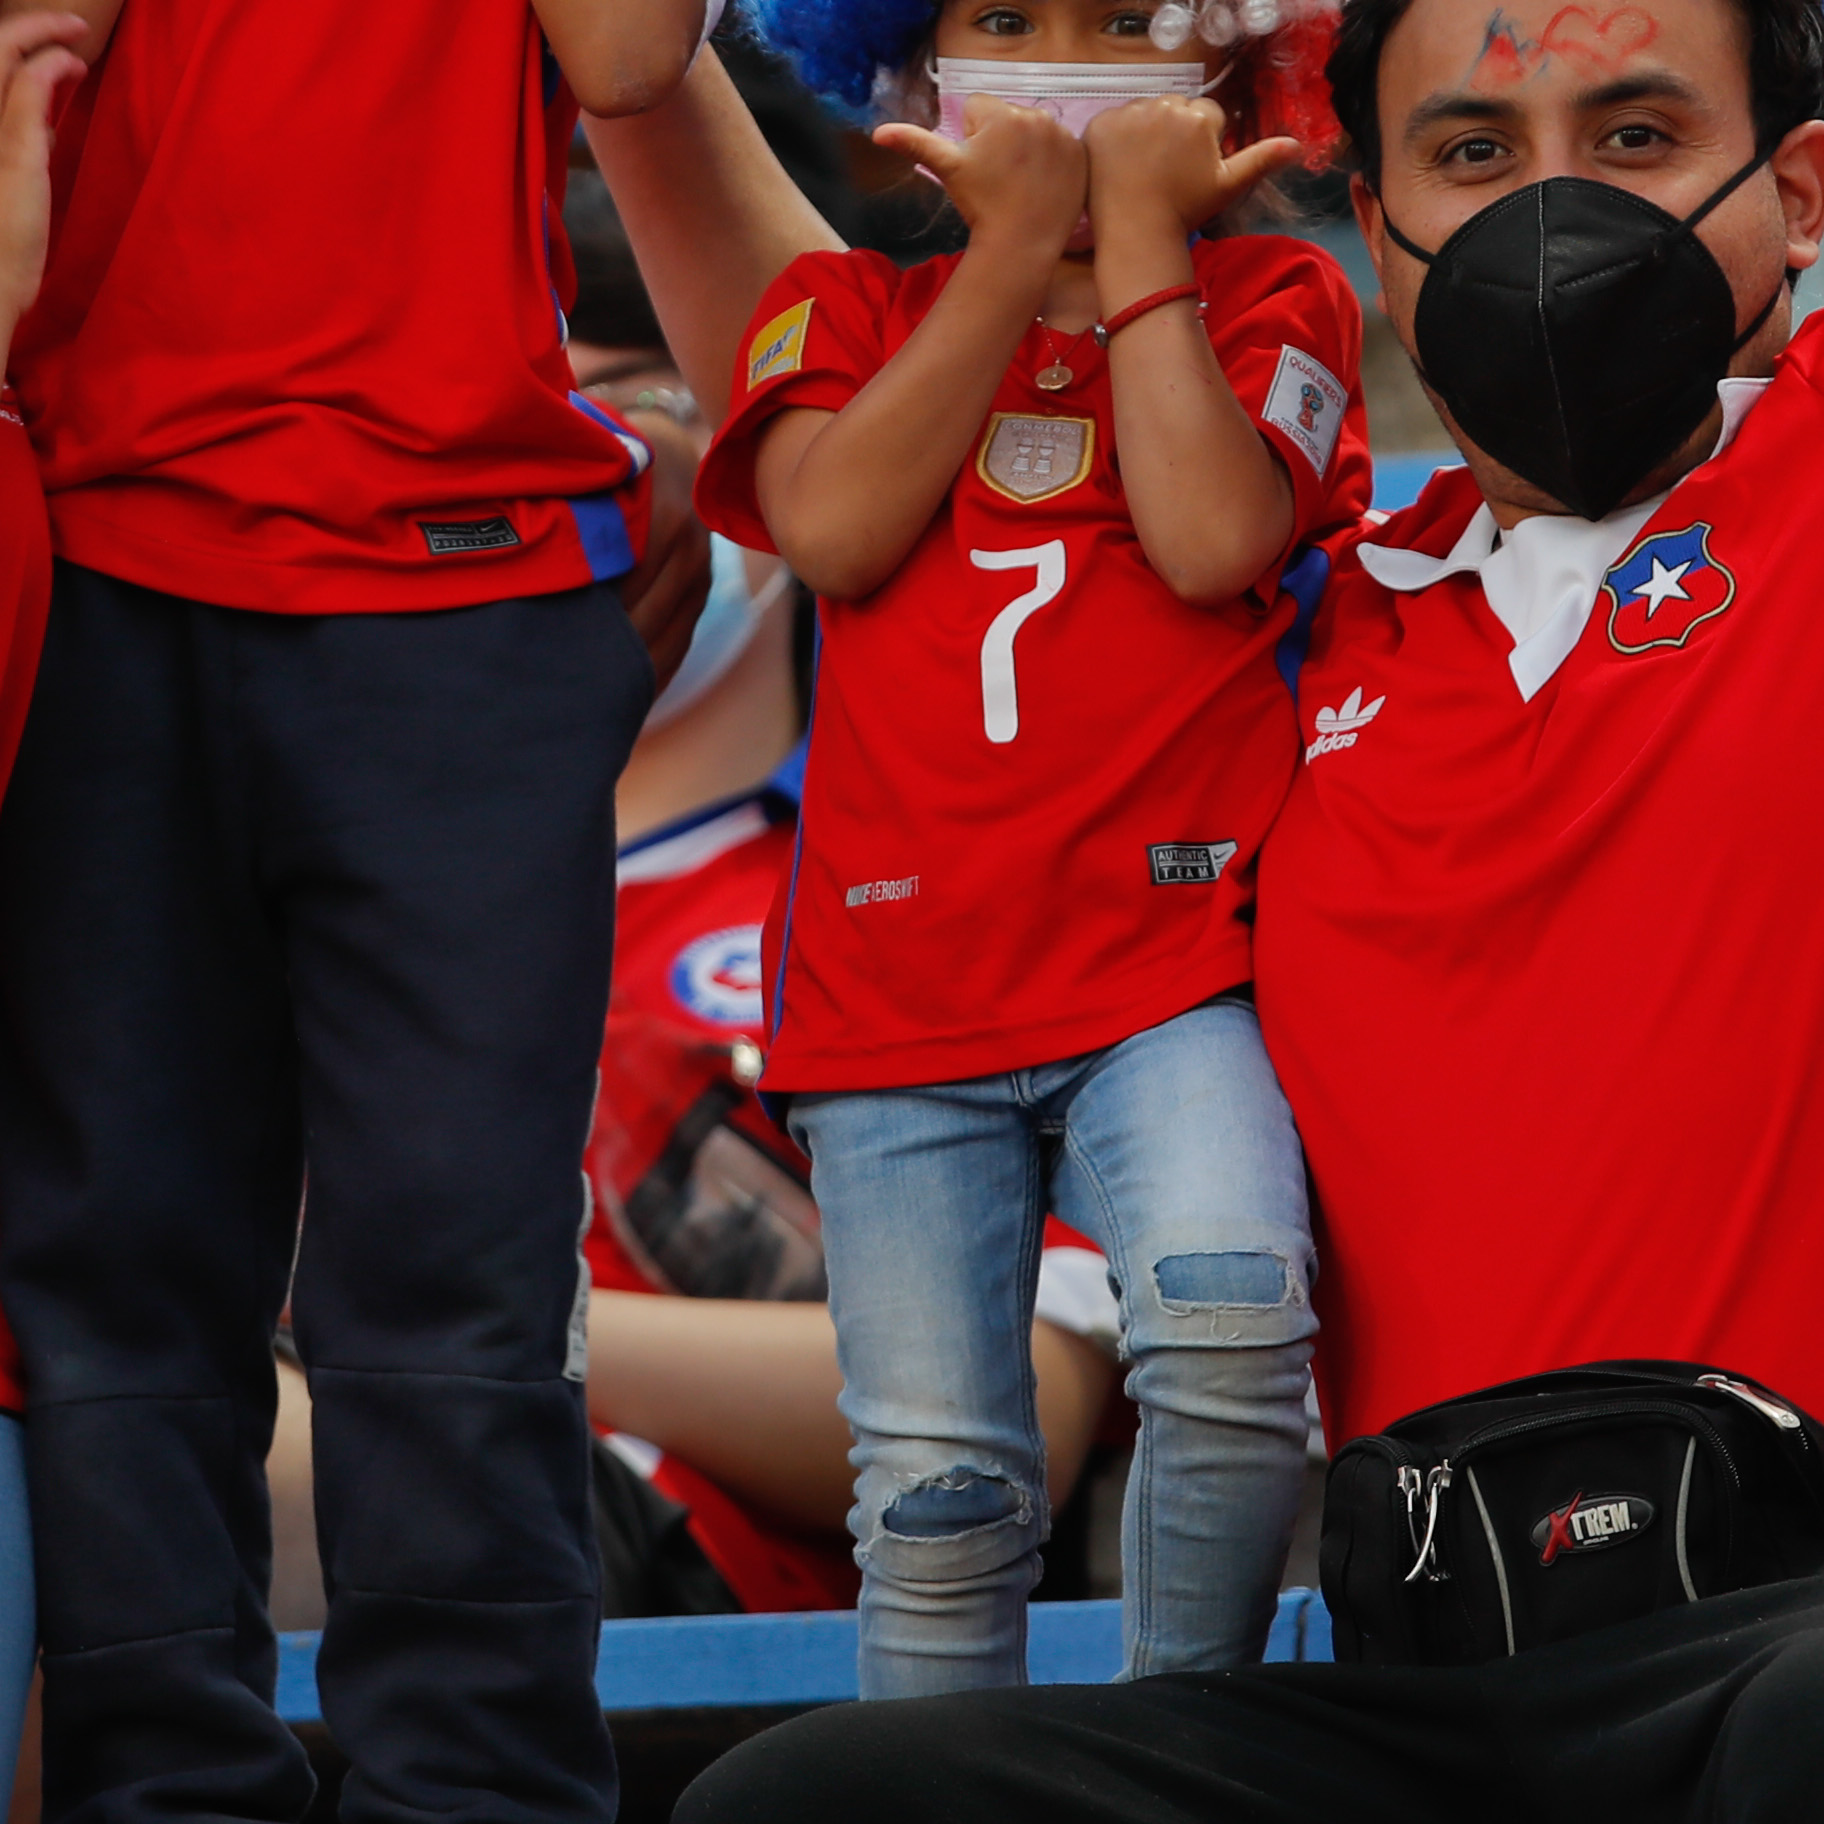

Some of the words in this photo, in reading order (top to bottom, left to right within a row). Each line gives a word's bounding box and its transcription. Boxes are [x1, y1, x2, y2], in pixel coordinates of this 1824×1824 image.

[751, 337, 785, 382] FIFA
[1289, 355, 1343, 409] QUALIFIERS
[969, 538, 1067, 744] 7
[1158, 849, 1209, 862] AUTHENTIC
[1161, 866, 1210, 880] TEAM
